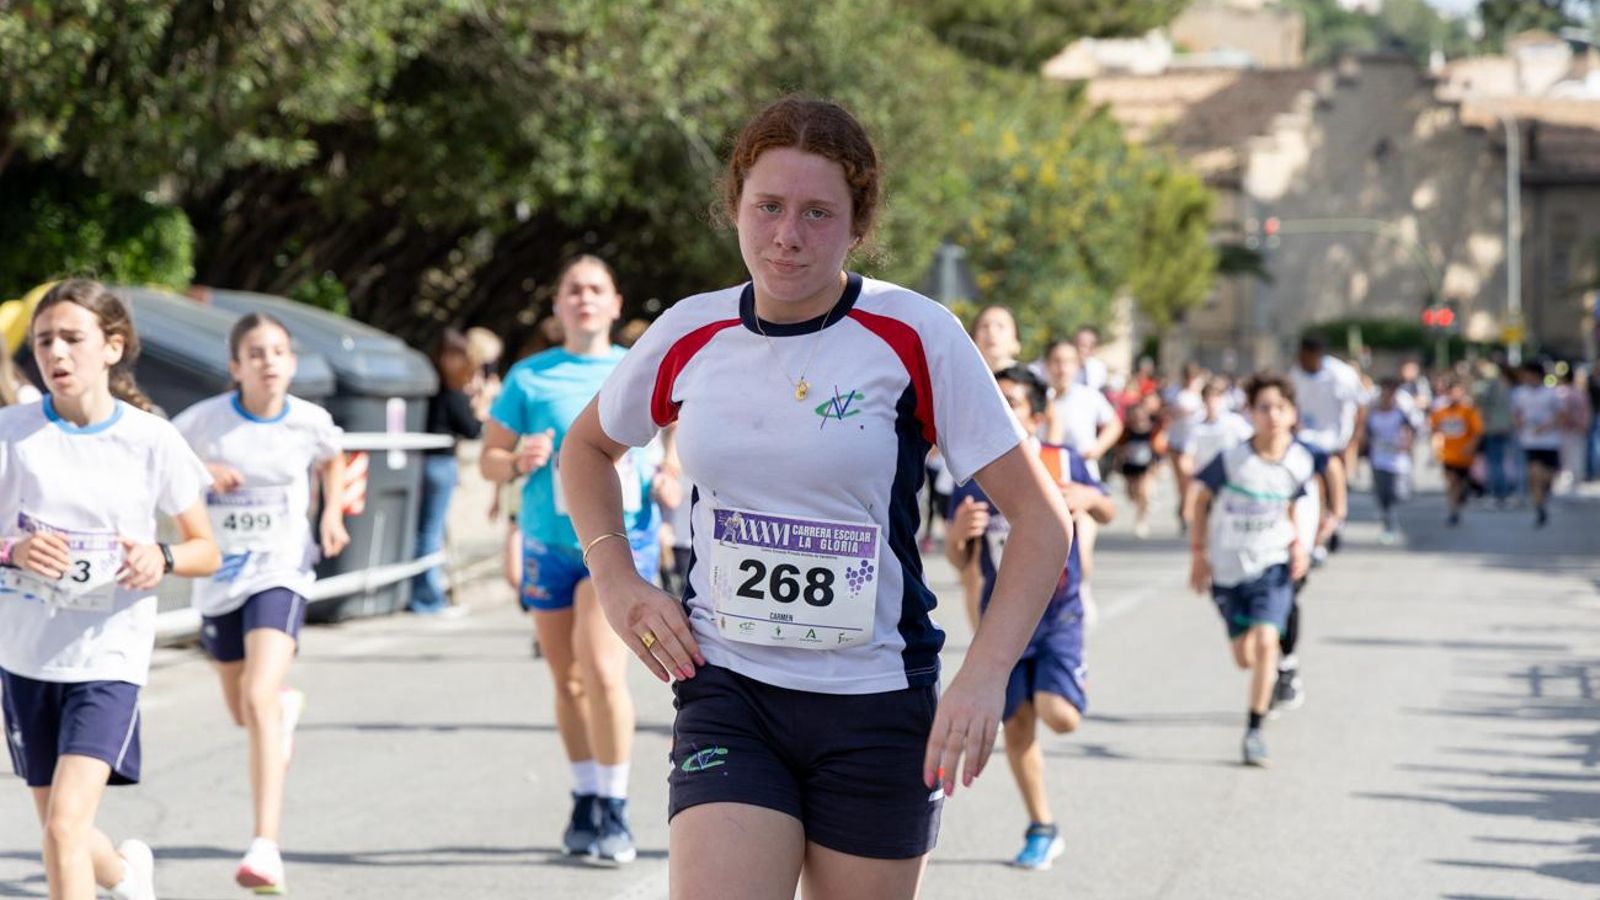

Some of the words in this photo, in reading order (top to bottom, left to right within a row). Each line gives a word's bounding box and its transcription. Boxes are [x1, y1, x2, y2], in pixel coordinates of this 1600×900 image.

[223, 513, 271, 531] 499
[739, 518, 790, 546] XXXVI
[792, 524, 832, 539] CARRERA
[834, 529, 871, 543] ESCOLAR
[798, 536, 812, 549] LA
[820, 538, 859, 554] GLORIA
[736, 559, 835, 607] 268
[769, 611, 794, 622] CARMEN
